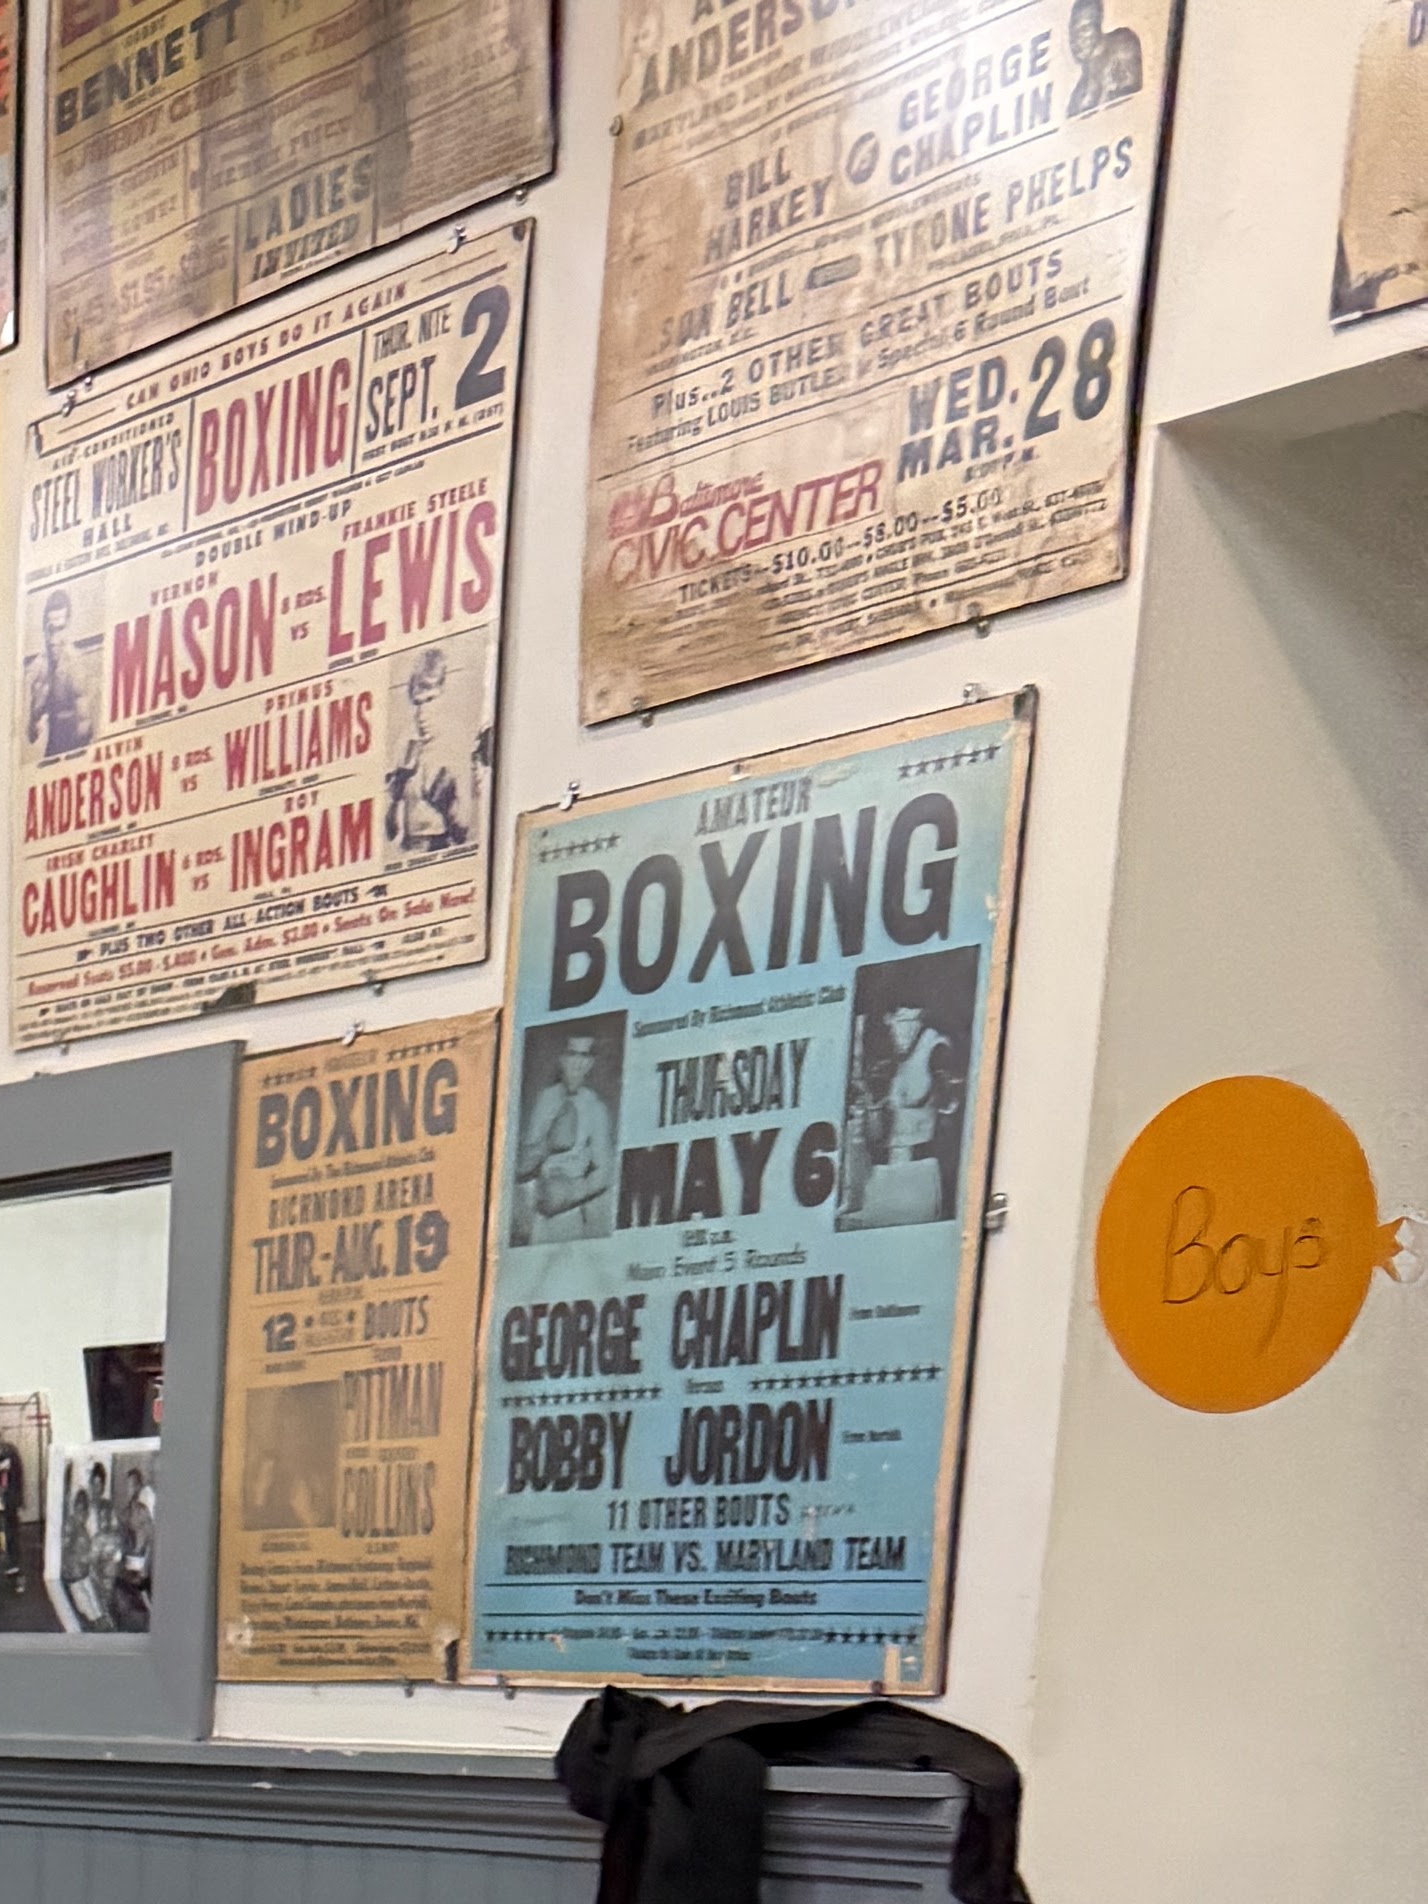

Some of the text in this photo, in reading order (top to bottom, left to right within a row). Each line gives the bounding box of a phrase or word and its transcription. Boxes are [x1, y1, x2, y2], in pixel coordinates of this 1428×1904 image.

[56, 3, 237, 135] BENNETT
[898, 28, 1053, 132] GEORGE
[725, 147, 791, 210] BILL
[888, 83, 1053, 186] CHAPLIN
[244, 153, 375, 251] LADIES
[703, 175, 834, 267] HARKEY
[725, 136, 1134, 330] BELL TYRONE PHELPS
[169, 360, 211, 390] OHIO
[221, 337, 269, 371] BOYS
[279, 325, 303, 347] DO
[314, 311, 332, 333] IT
[343, 284, 407, 322] AGAIN
[418, 303, 452, 346] NITE
[454, 284, 510, 410] 2
[748, 249, 1064, 382] OTHER GREAT BOUTS
[365, 354, 439, 444] SEPT.
[907, 355, 1020, 436] WED.
[1023, 316, 1118, 440] 28
[195, 357, 352, 516] BOXING
[896, 416, 1016, 486] MAR.
[30, 470, 83, 543] STEEL
[83, 519, 133, 548] HALL
[195, 500, 352, 568] DOUBLE WIND-UP
[343, 478, 488, 543] FRANKIE STEELE
[717, 459, 886, 558] CENTER
[109, 499, 498, 722] MASON LEWIS
[150, 572, 218, 607] VERNON
[291, 621, 309, 640] VS
[94, 680, 334, 762] ALVIN PRIMUS
[24, 691, 374, 844] ANDERSON WILLIAMS
[180, 775, 198, 793] VS
[695, 775, 813, 837] AMATEUR
[22, 849, 177, 938] CAUGHLIN
[230, 798, 374, 892] INGRAM
[47, 790, 319, 872] IRISH CHARLEY ROY
[100, 938, 130, 962] PLUS
[174, 920, 214, 943] OTHER
[255, 900, 305, 926] ACTION
[312, 887, 358, 914] BOUTS
[193, 873, 209, 892] VS
[549, 792, 960, 1012] BOXING
[255, 1057, 459, 1169] BOXING
[656, 1037, 812, 1128] THURSDAY
[268, 1172, 434, 1230] RICHMOND ARENA
[616, 1120, 839, 1230] MAY 6
[394, 1210, 450, 1278] 19
[1162, 1185, 1327, 1359] Boys
[263, 1294, 430, 1353] 12 BOUTS
[501, 1273, 845, 1383] GEORGE CHAPLIN
[507, 1399, 834, 1495] BOBBY JORDON
[607, 1492, 791, 1531] 11 OTHER BOUTS
[609, 1544, 666, 1574] TEAM
[675, 1541, 708, 1572] VS.
[714, 1538, 834, 1572] MARYLAND
[844, 1536, 907, 1571] TEAM
